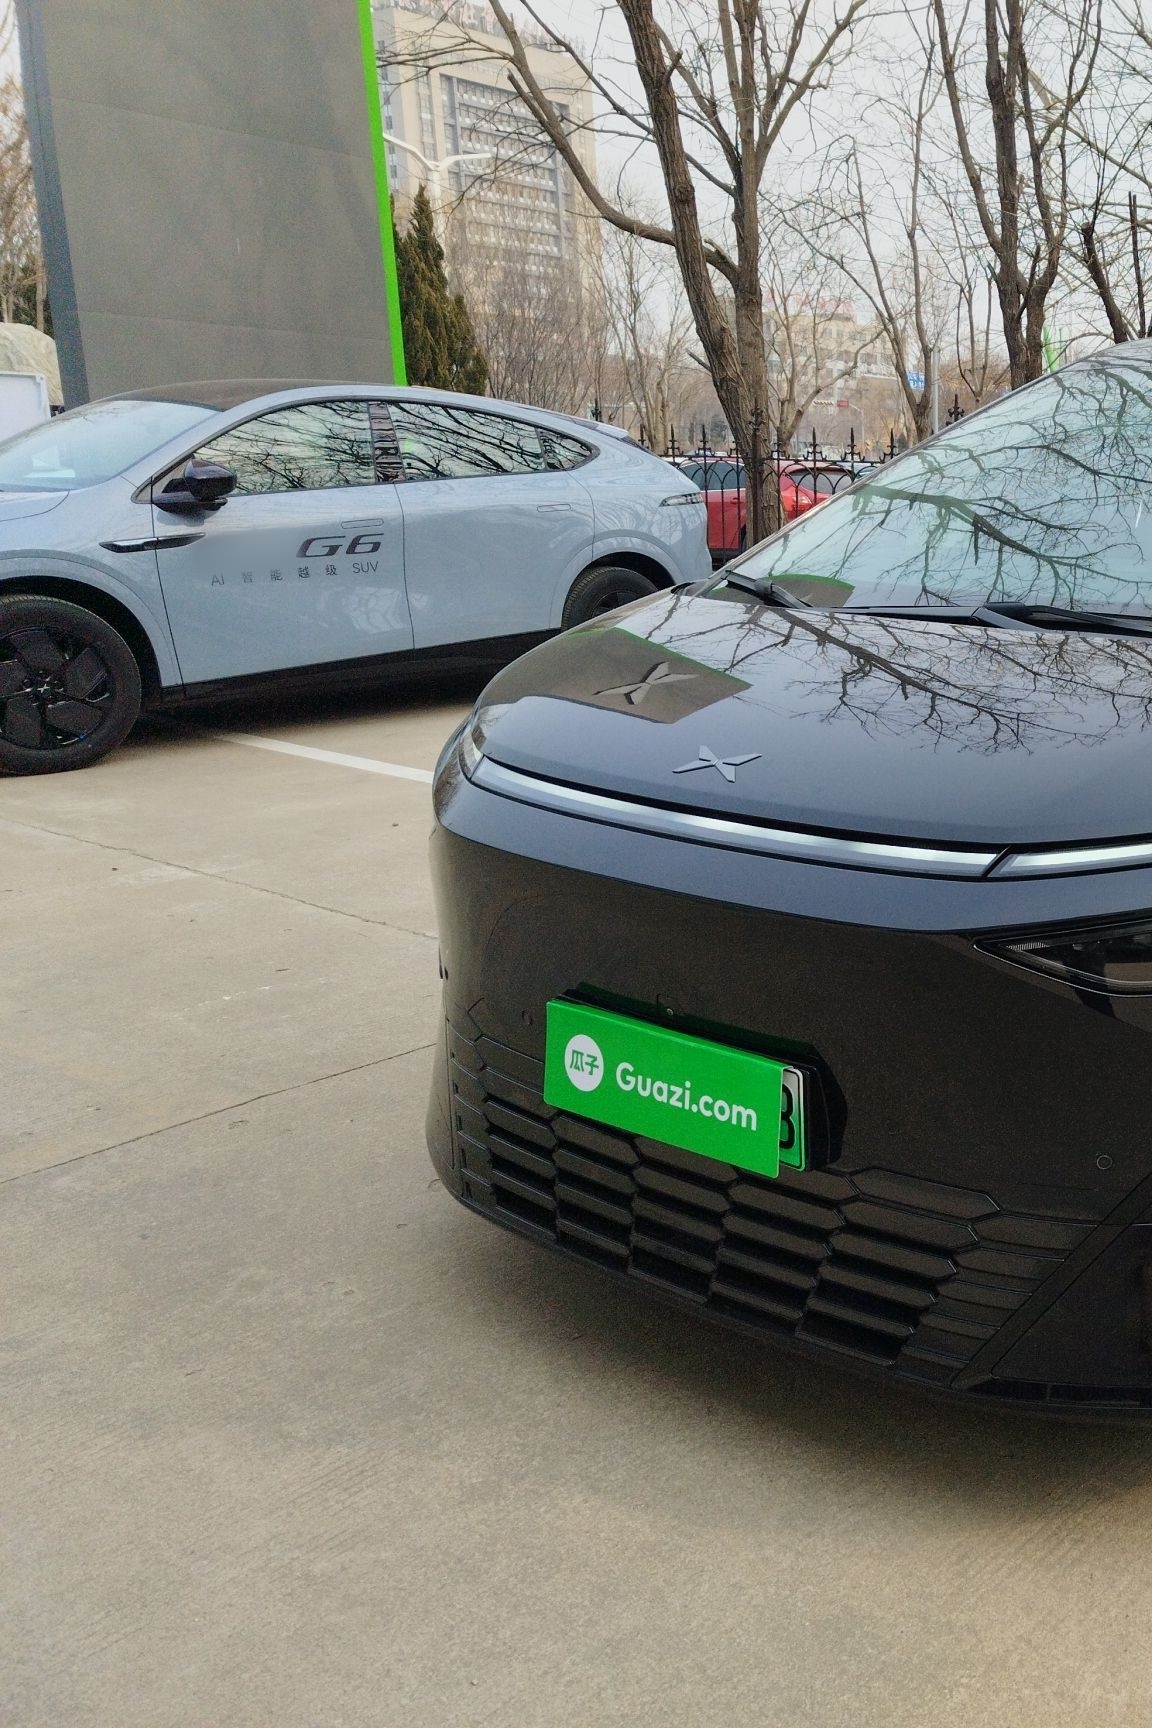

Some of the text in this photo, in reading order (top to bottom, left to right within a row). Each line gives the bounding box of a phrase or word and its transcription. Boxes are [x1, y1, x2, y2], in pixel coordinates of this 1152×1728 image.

[297, 533, 384, 558] G6
[211, 574, 225, 586] AI
[352, 561, 379, 574] SUV
[569, 1050, 599, 1076] 瓜子
[616, 1062, 757, 1131] Guazi.com
